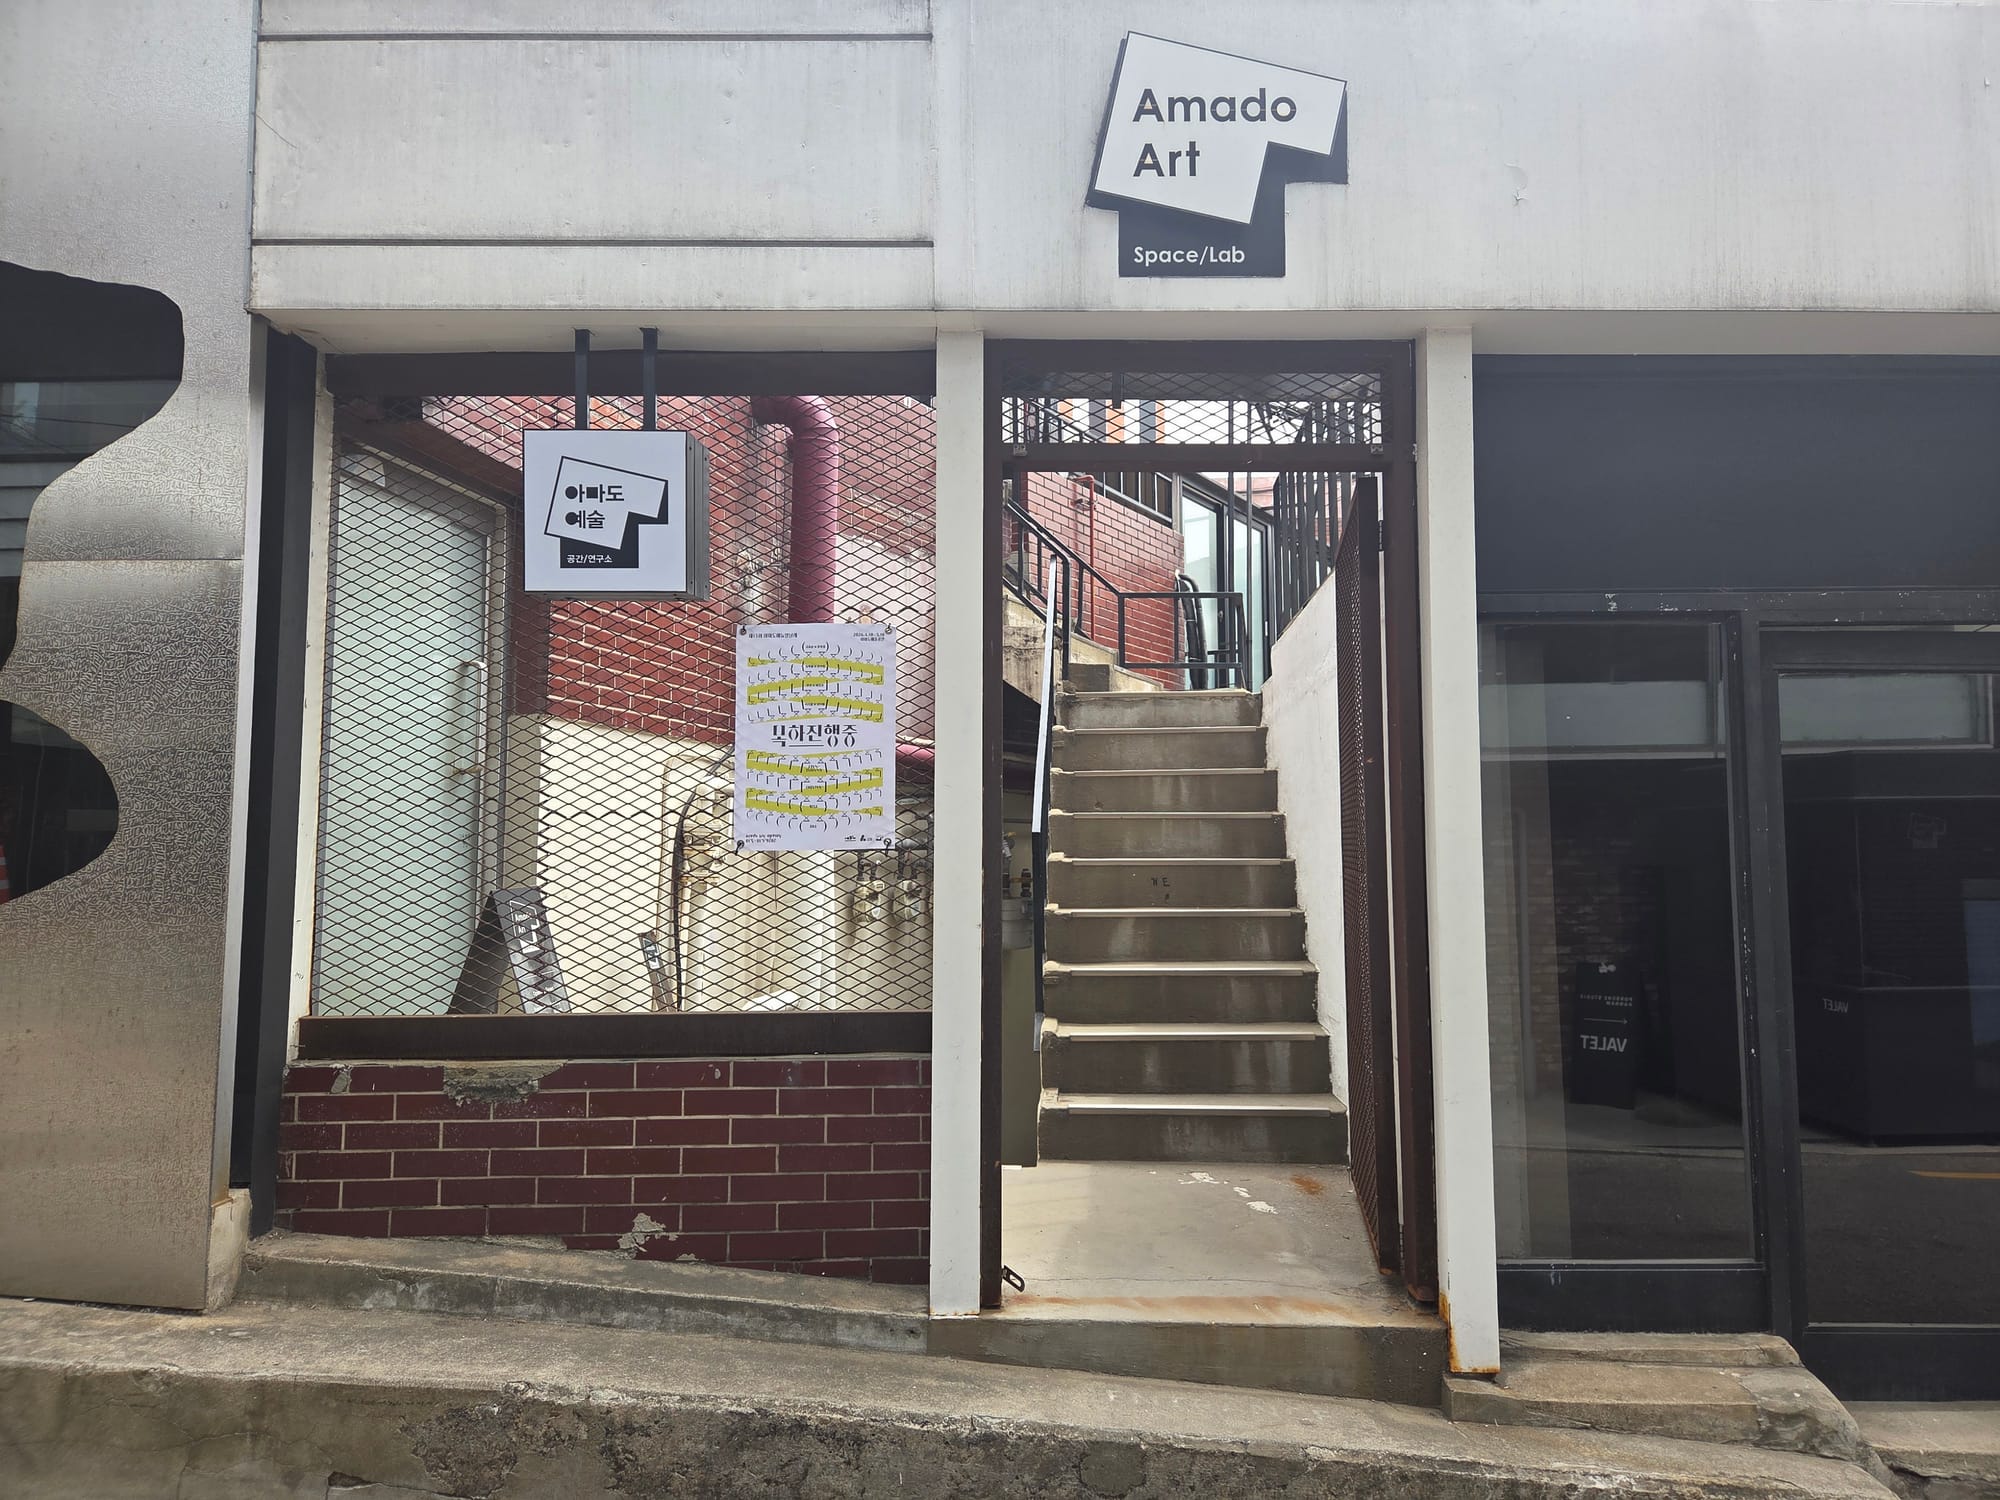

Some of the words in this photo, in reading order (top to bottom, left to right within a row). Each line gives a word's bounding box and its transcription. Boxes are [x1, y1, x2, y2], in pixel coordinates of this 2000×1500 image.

[1132, 87, 1297, 122] Amado
[1133, 141, 1200, 177] Art
[1133, 246, 1246, 266] Space/Lab
[565, 484, 625, 503] 아마도
[565, 510, 606, 529] 예술
[566, 554, 613, 563] 공간/연구소
[771, 724, 857, 747] 목하진행중
